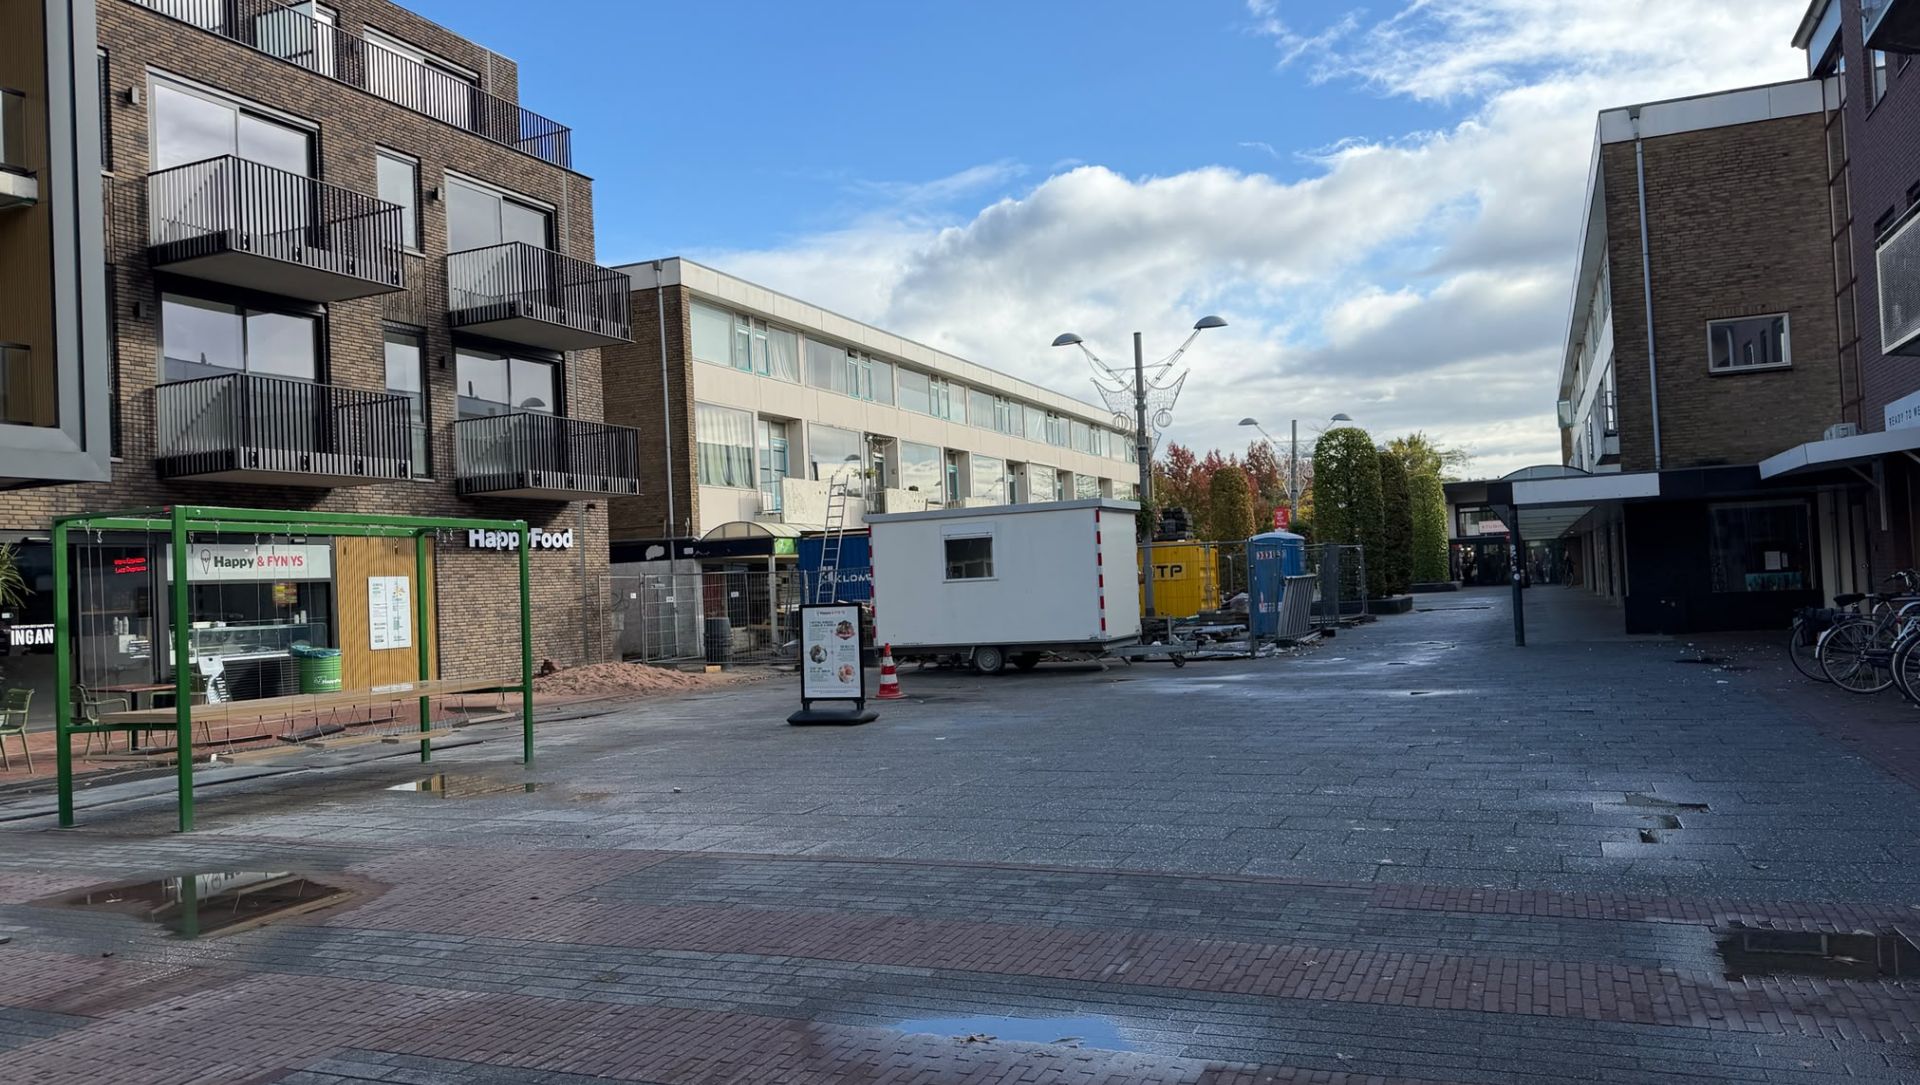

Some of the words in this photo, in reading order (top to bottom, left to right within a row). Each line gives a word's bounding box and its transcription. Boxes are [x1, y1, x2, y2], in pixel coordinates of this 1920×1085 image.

[469, 528, 573, 550] HappFood
[214, 556, 254, 568] Happy
[257, 555, 265, 567] &
[267, 555, 288, 567] FYN
[11, 628, 55, 646] INGAN
